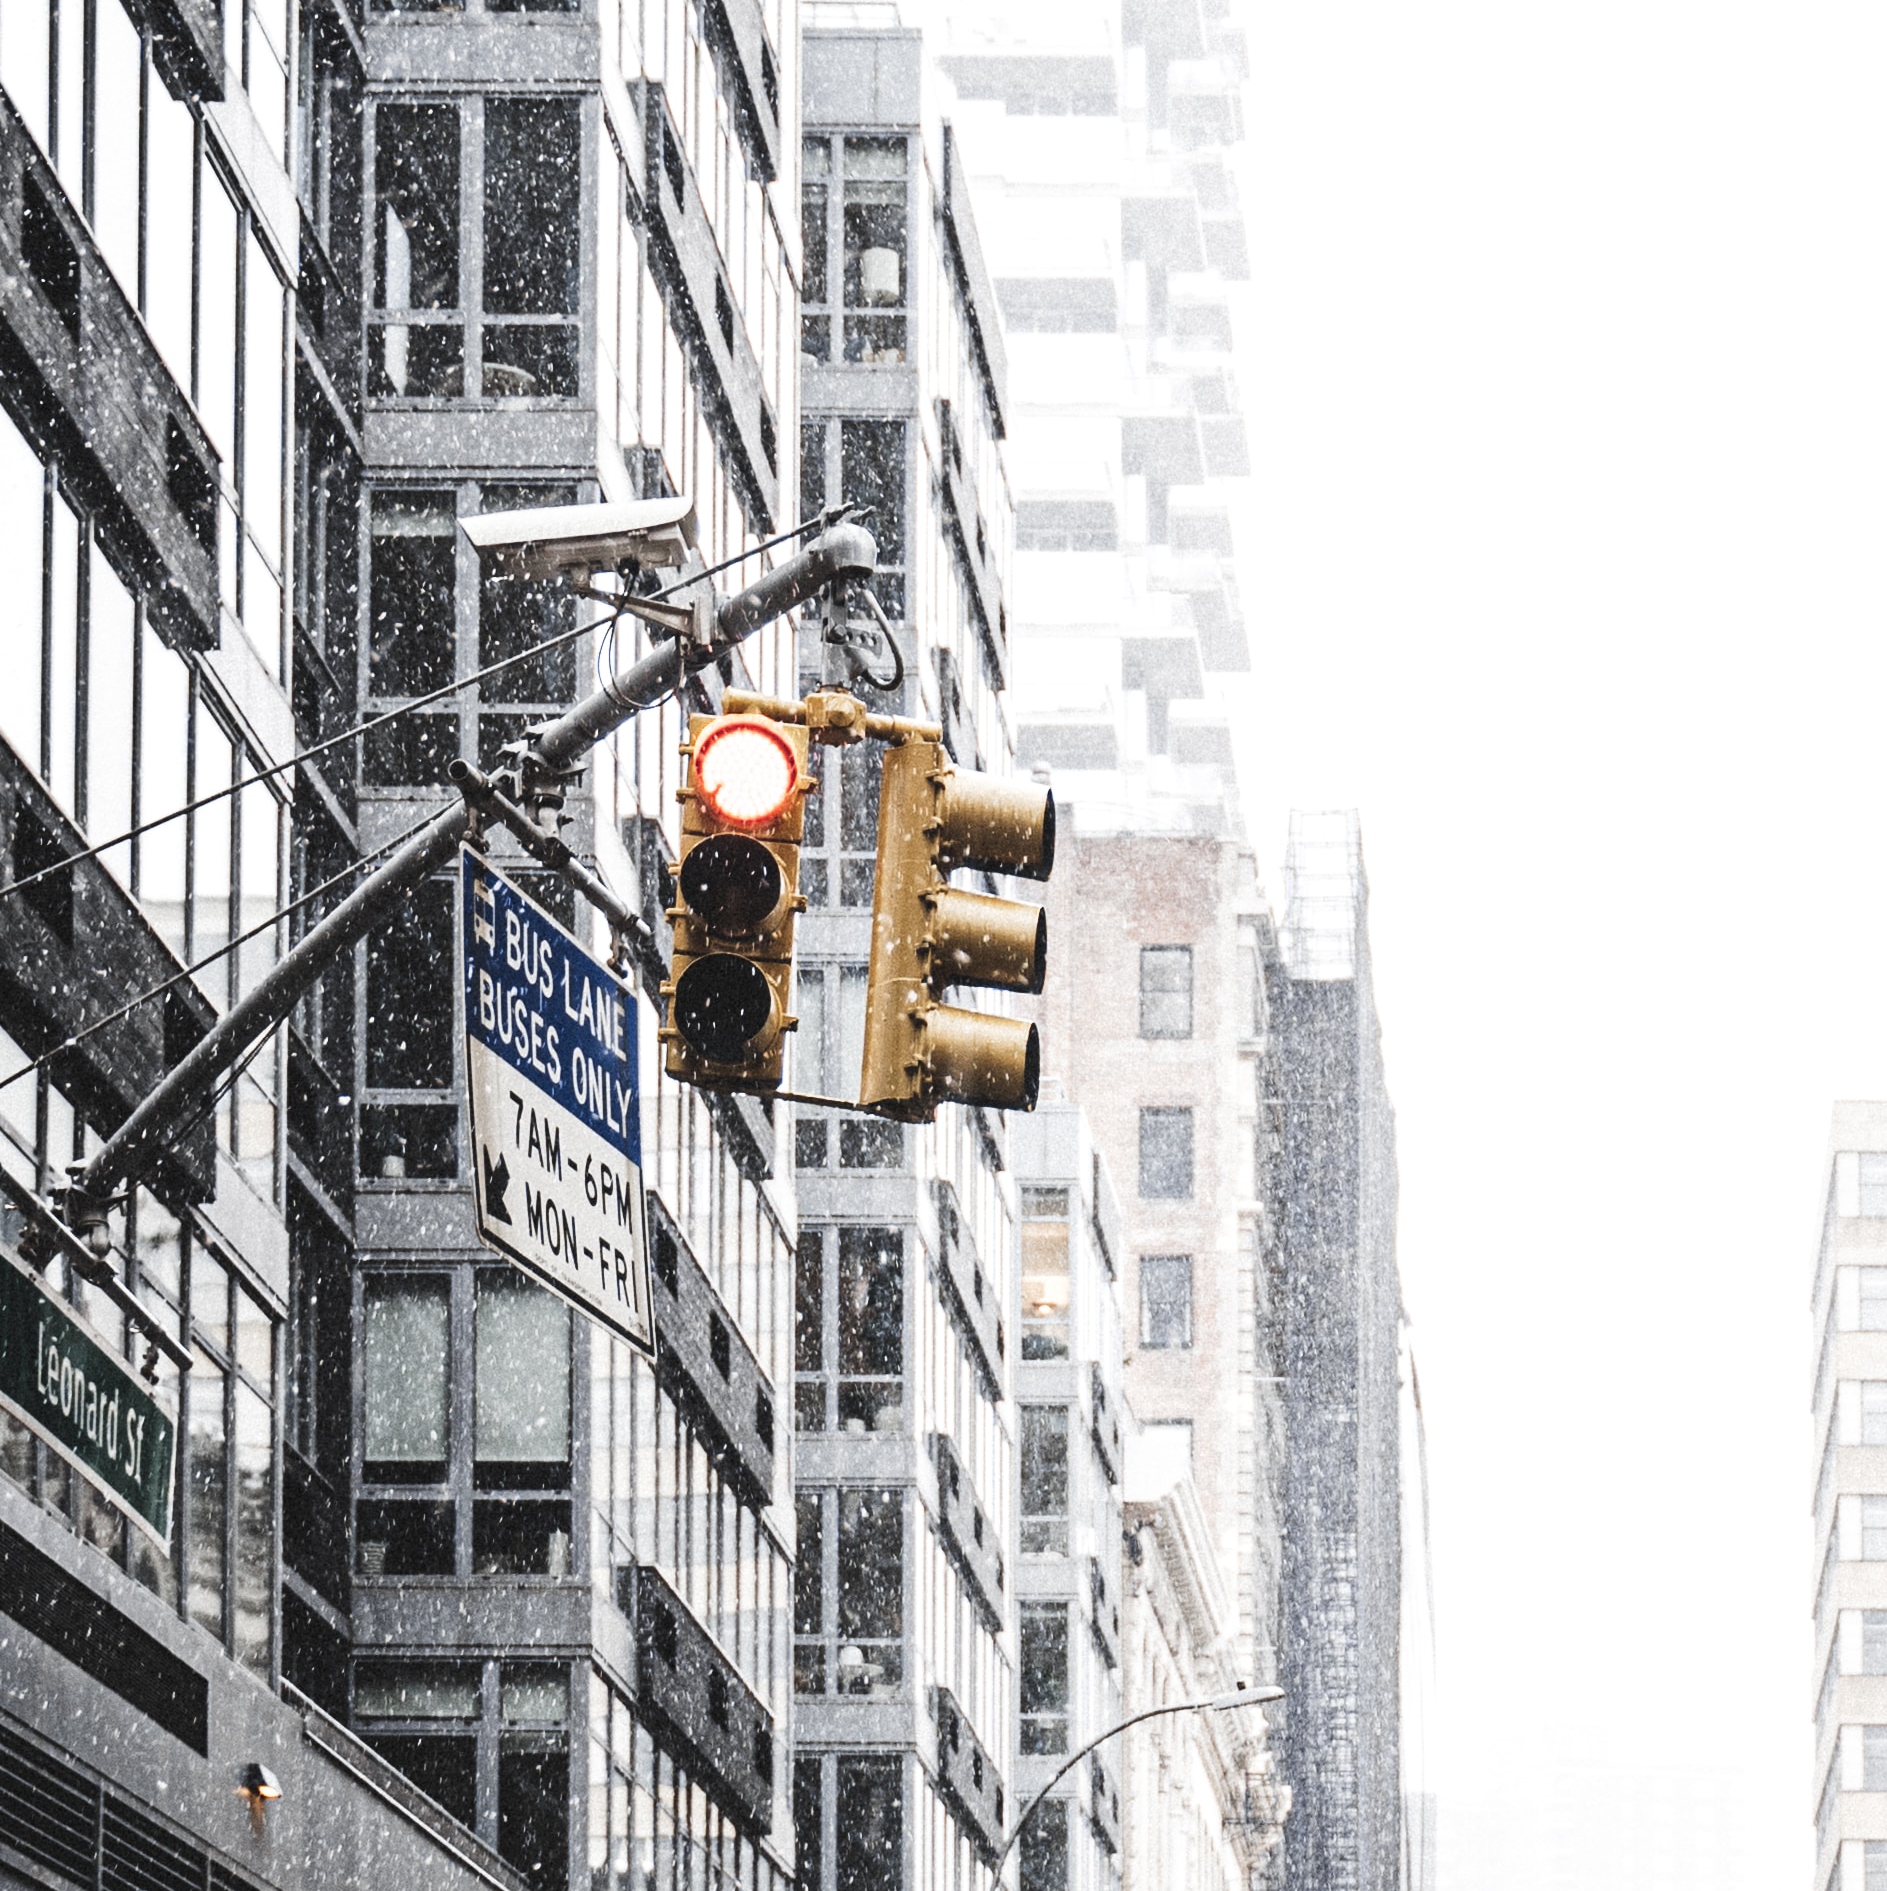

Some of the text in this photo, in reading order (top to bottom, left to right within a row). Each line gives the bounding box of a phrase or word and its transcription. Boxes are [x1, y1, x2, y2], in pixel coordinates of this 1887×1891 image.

[478, 968, 632, 1139] BUSES ONLY
[507, 910, 628, 1062] BUS LANE
[37, 1321, 145, 1486] Leonard St
